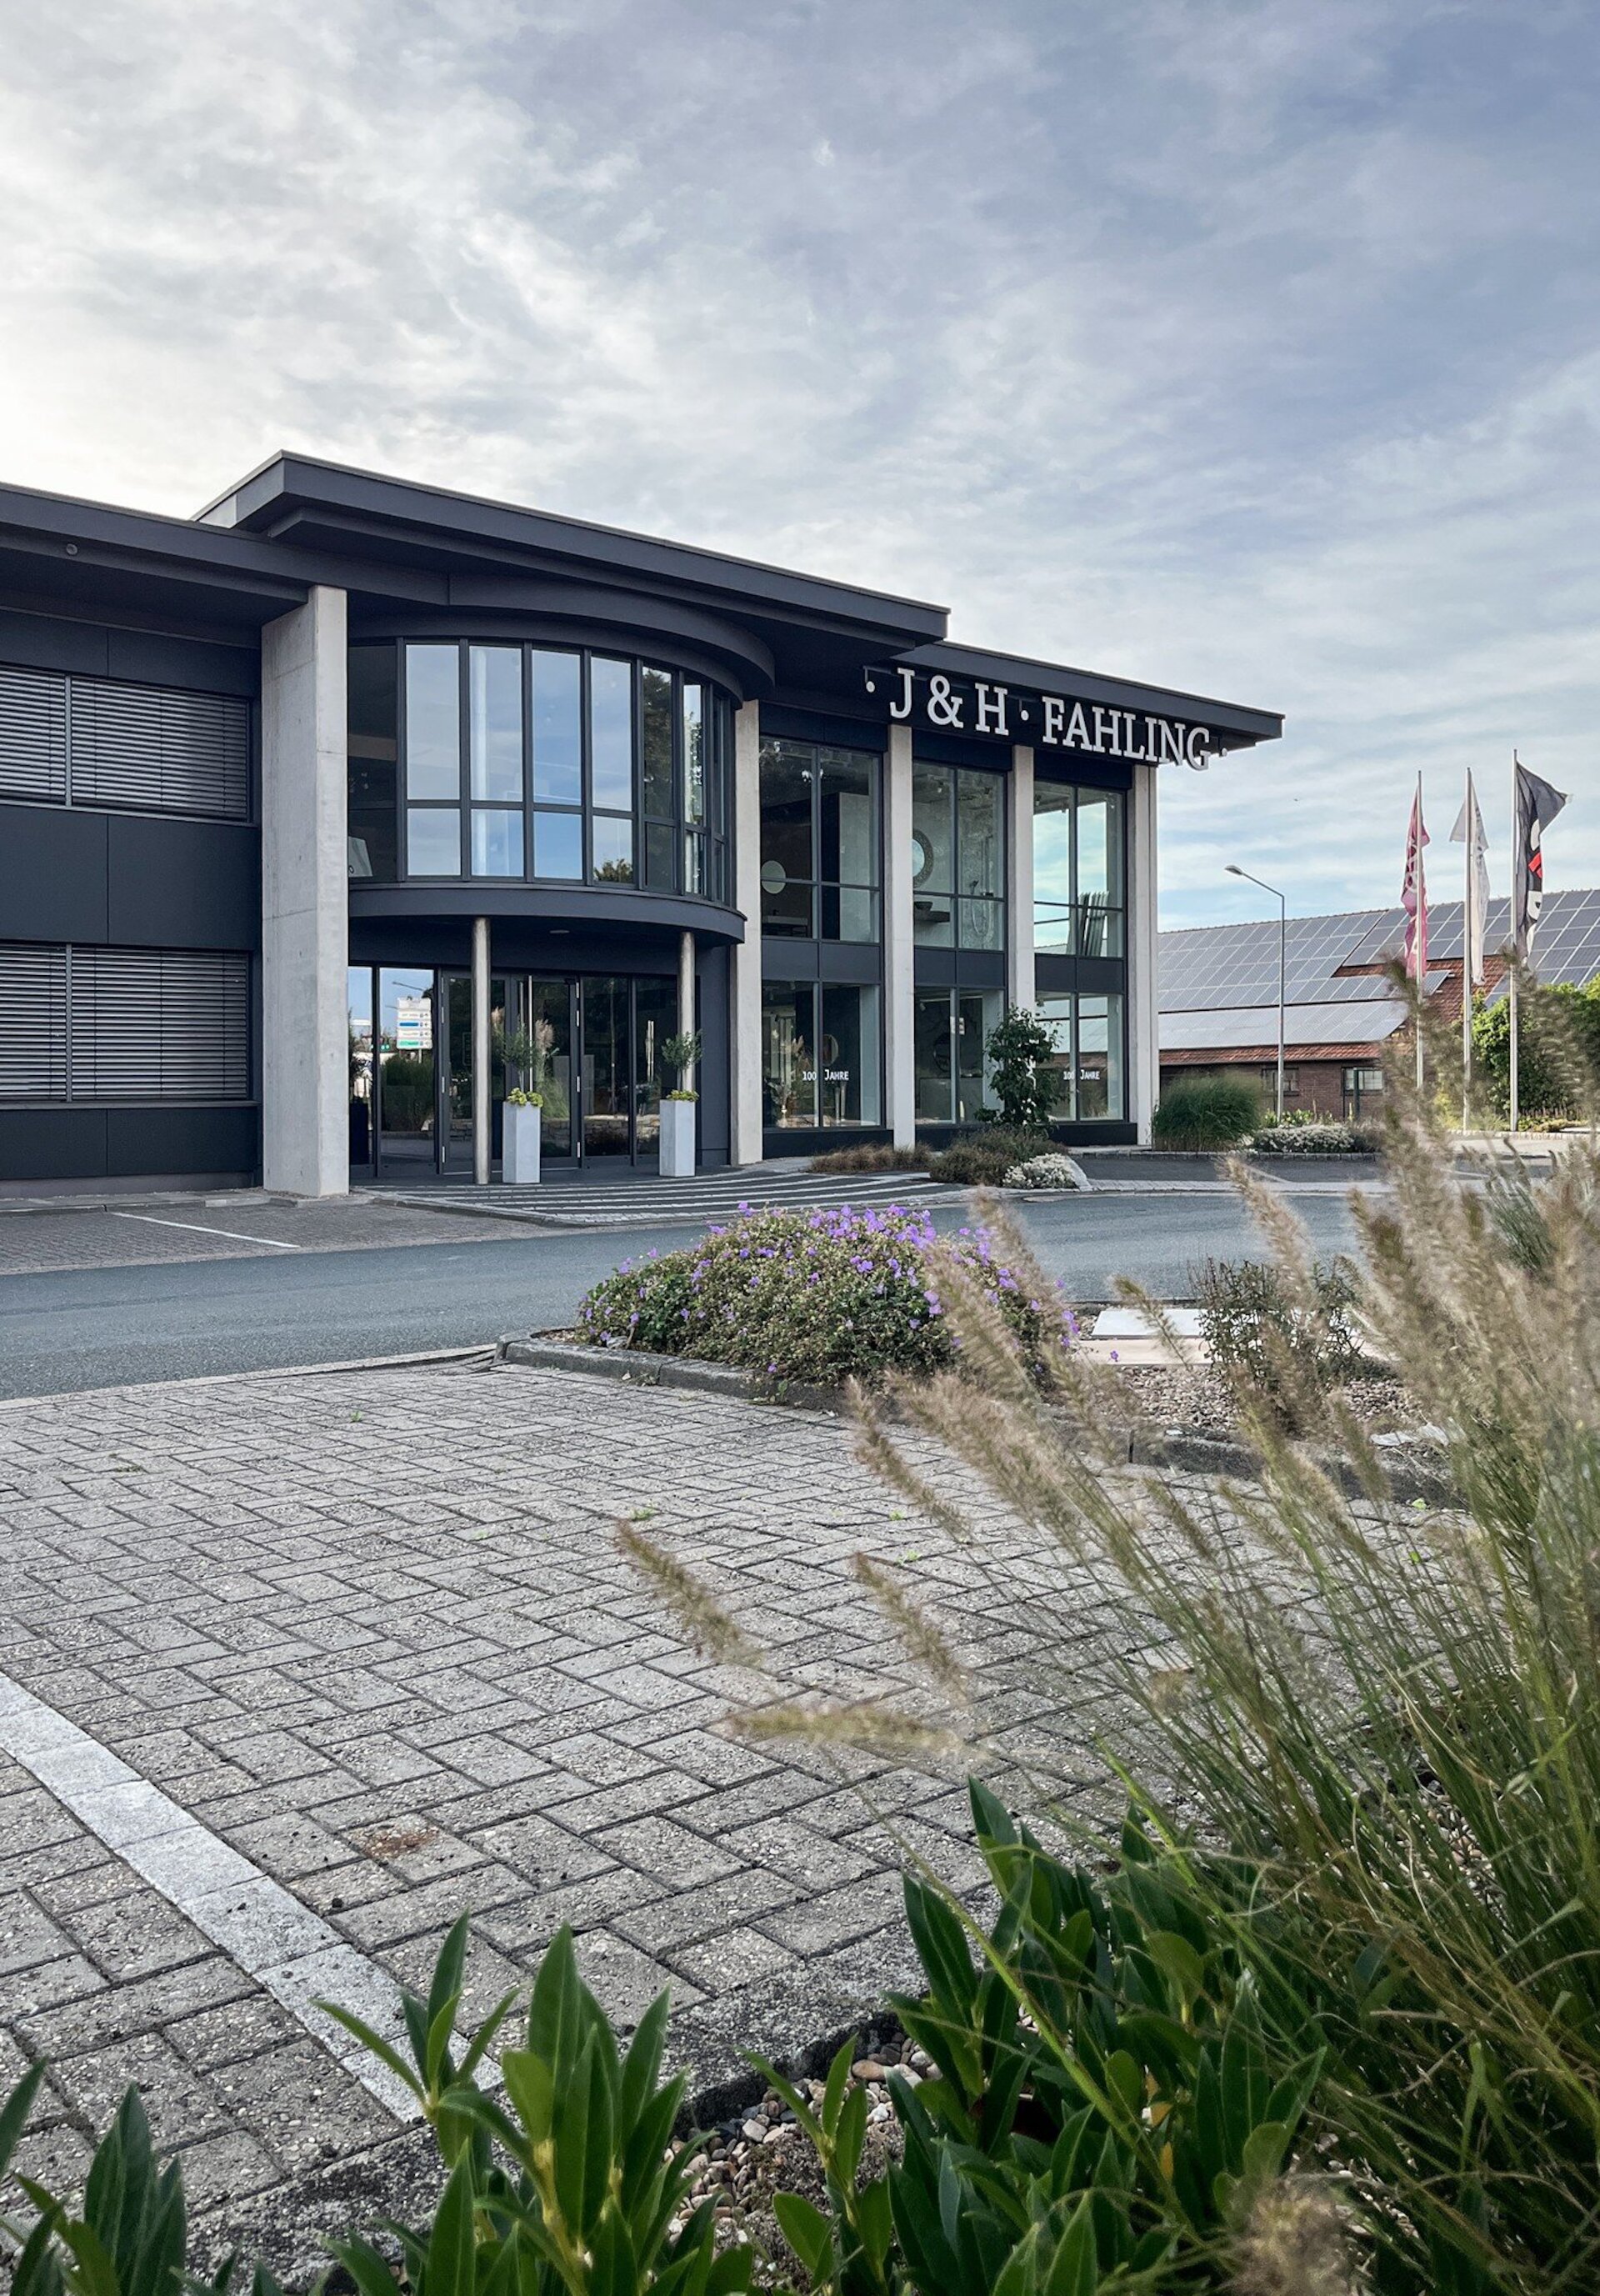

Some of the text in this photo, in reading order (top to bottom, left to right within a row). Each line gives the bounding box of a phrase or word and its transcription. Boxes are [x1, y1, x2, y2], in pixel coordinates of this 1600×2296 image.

[889, 667, 1212, 772] J & H FAHLING
[802, 1068, 850, 1082] 100 JAHRE
